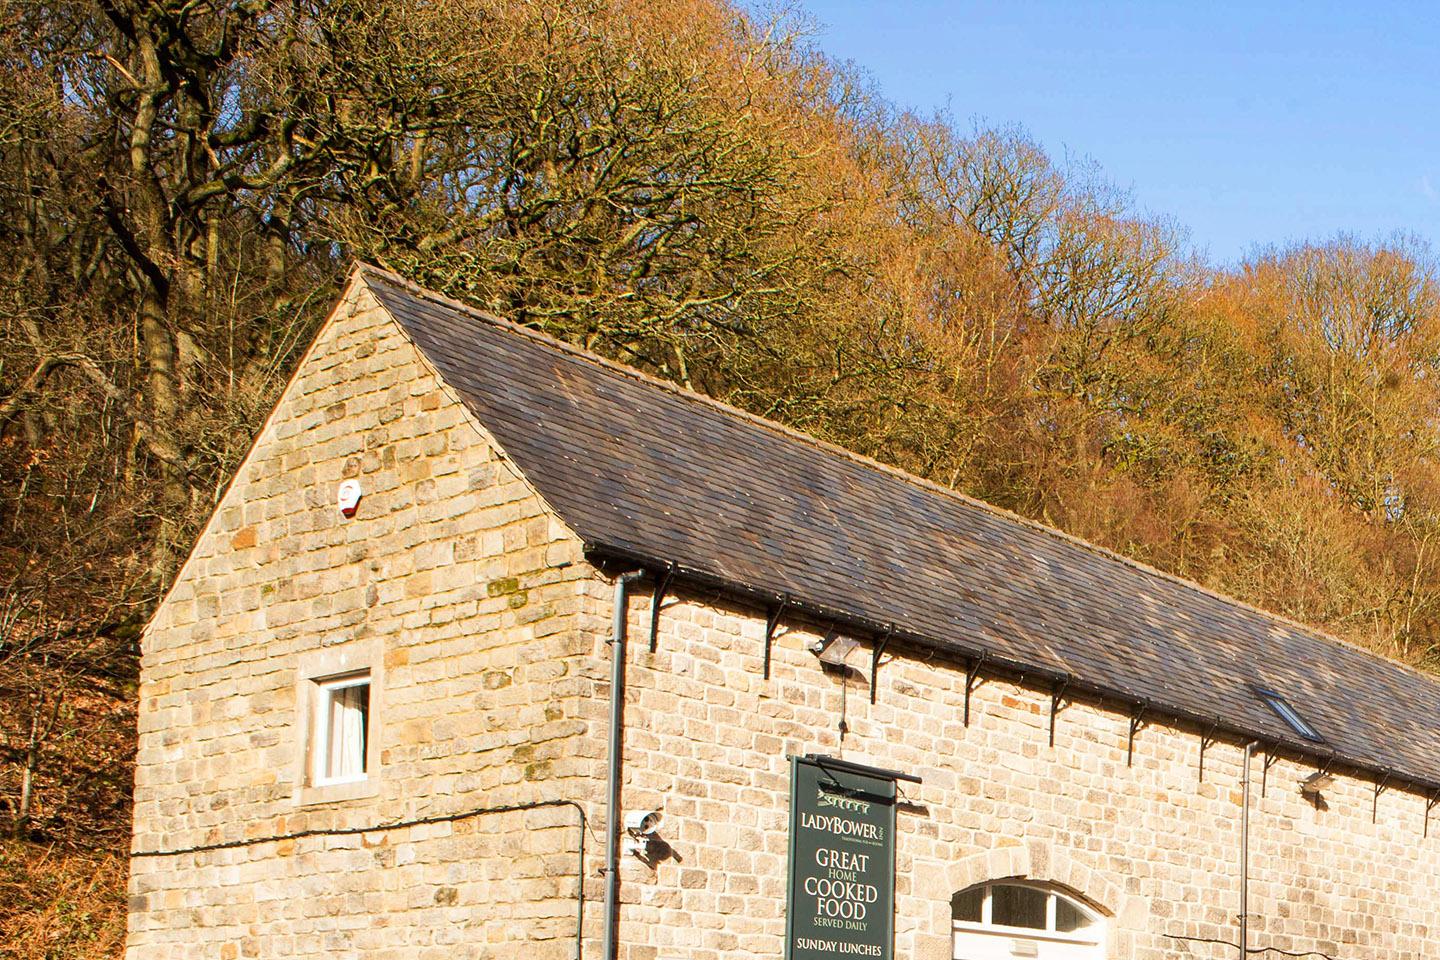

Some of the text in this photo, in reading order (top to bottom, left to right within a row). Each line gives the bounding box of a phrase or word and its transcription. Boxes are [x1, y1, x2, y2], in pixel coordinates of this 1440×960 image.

[801, 812, 878, 840] LADYBOWER
[815, 848, 870, 873] GREAT
[828, 868, 858, 882] HOME
[804, 876, 878, 903] COOKED
[817, 896, 867, 920] FOOD
[813, 916, 868, 932] SERVED DAILY
[797, 938, 882, 957] SUNDAY LUNCHES
